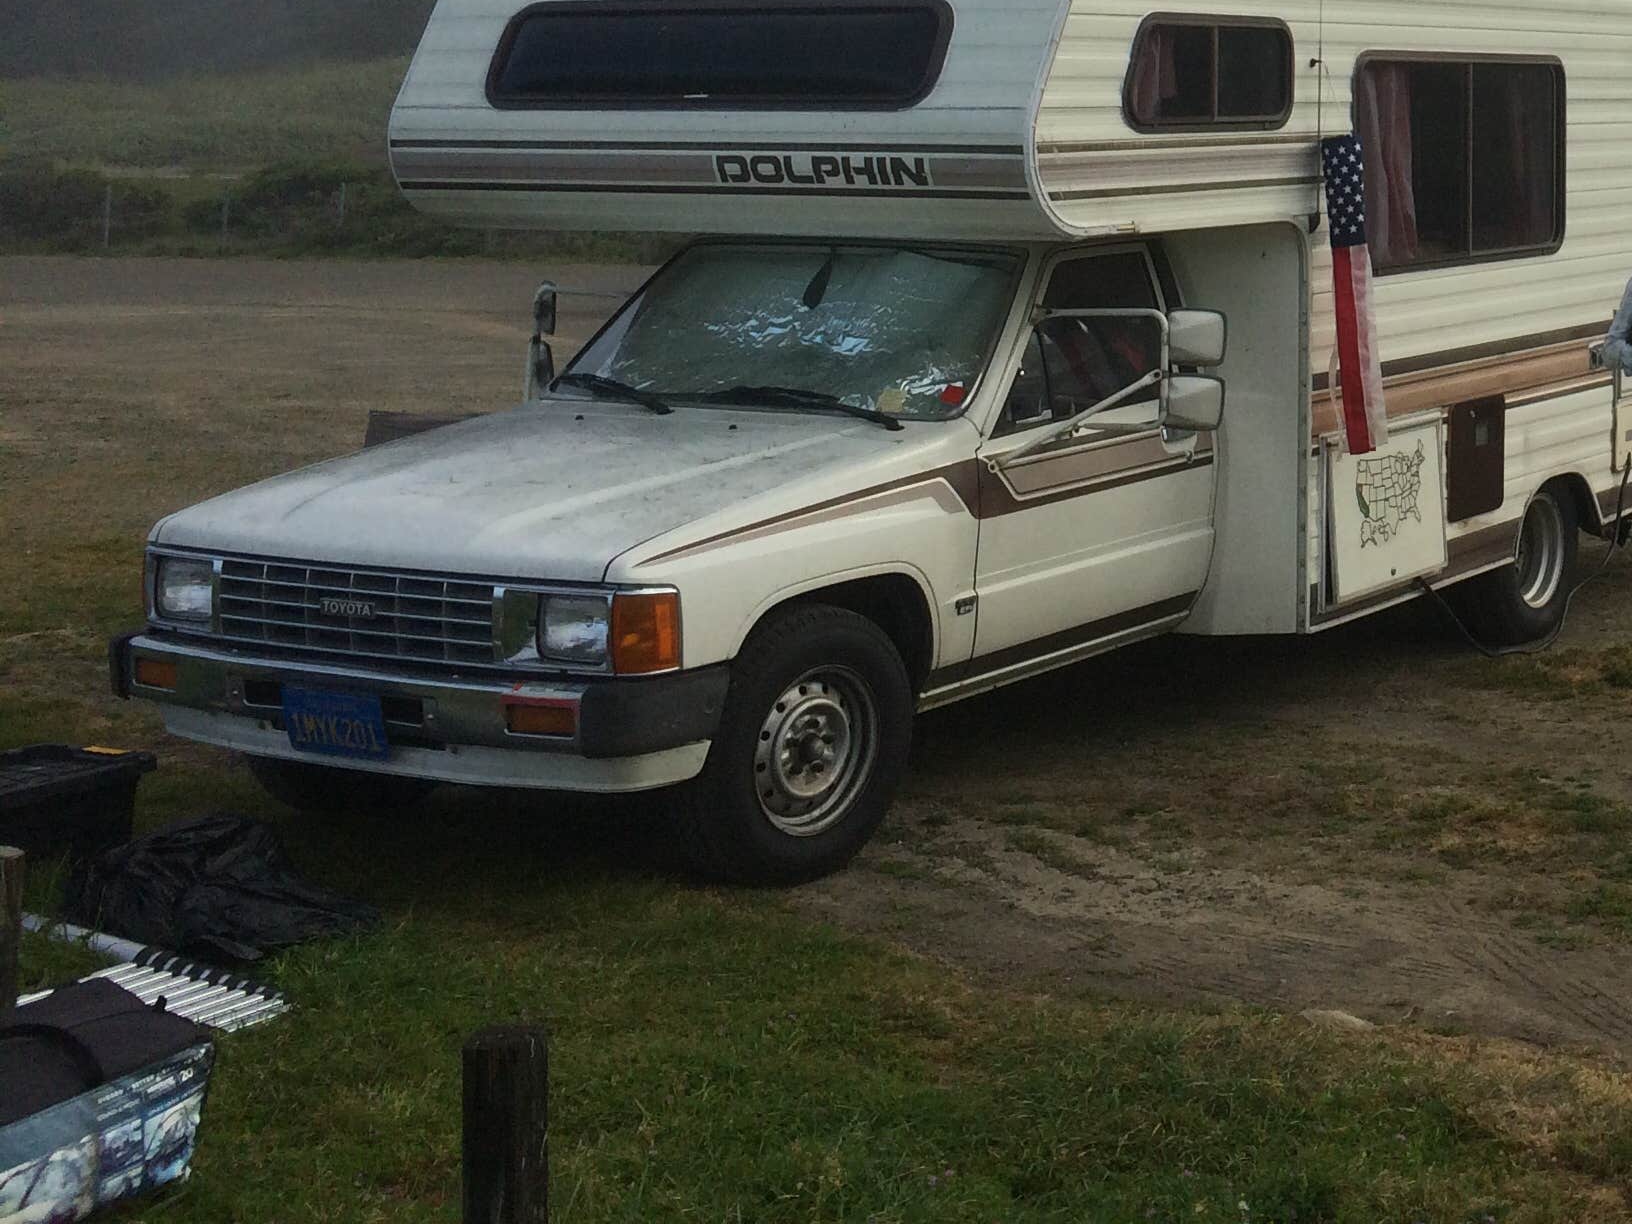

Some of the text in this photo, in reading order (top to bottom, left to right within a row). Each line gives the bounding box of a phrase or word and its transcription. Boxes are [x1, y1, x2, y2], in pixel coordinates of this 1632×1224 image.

[716, 154, 929, 186] DOLPHIN
[322, 600, 371, 616] TOYOTA
[290, 712, 383, 752] 1MYK201
